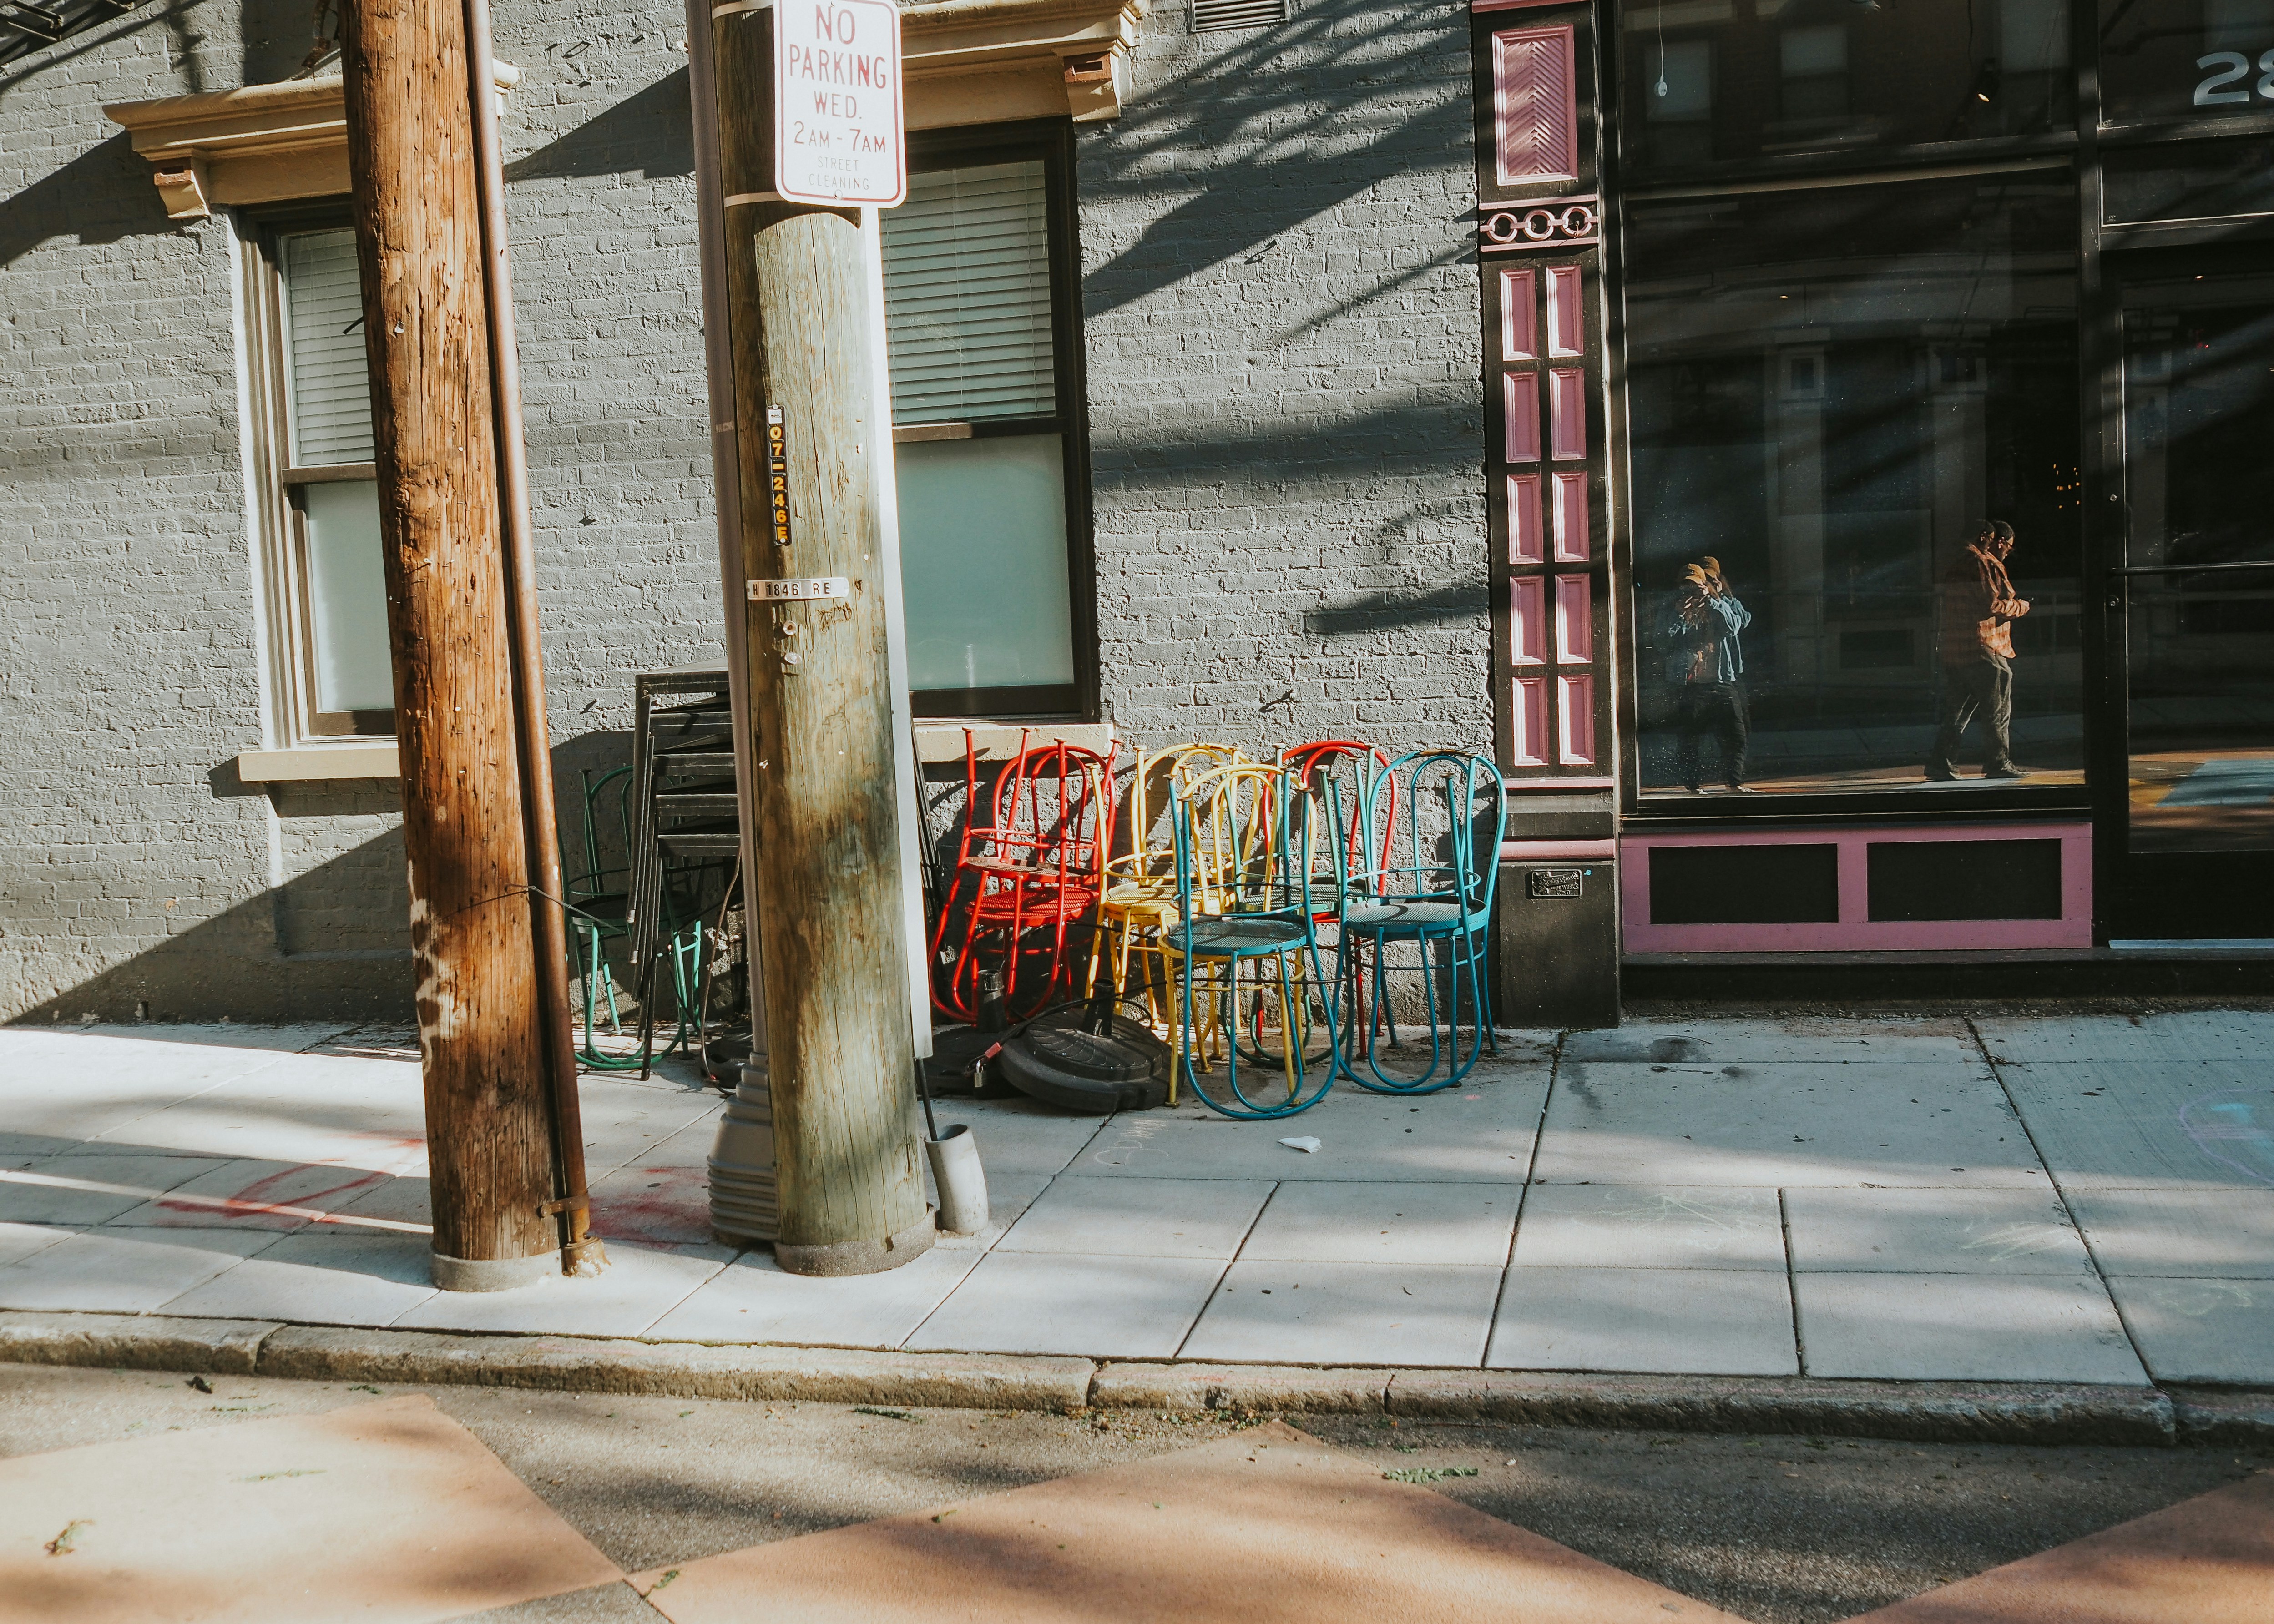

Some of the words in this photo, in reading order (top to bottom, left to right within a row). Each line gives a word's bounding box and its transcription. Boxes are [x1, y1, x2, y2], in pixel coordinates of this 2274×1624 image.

[816, 5, 855, 44] NO
[790, 44, 886, 88] PARKING
[814, 91, 862, 119] WED.
[794, 121, 829, 148] 2AM
[849, 129, 885, 152] 7AM
[818, 156, 858, 171] STREET
[809, 174, 869, 190] CLEANING
[766, 582, 800, 596] 1846
